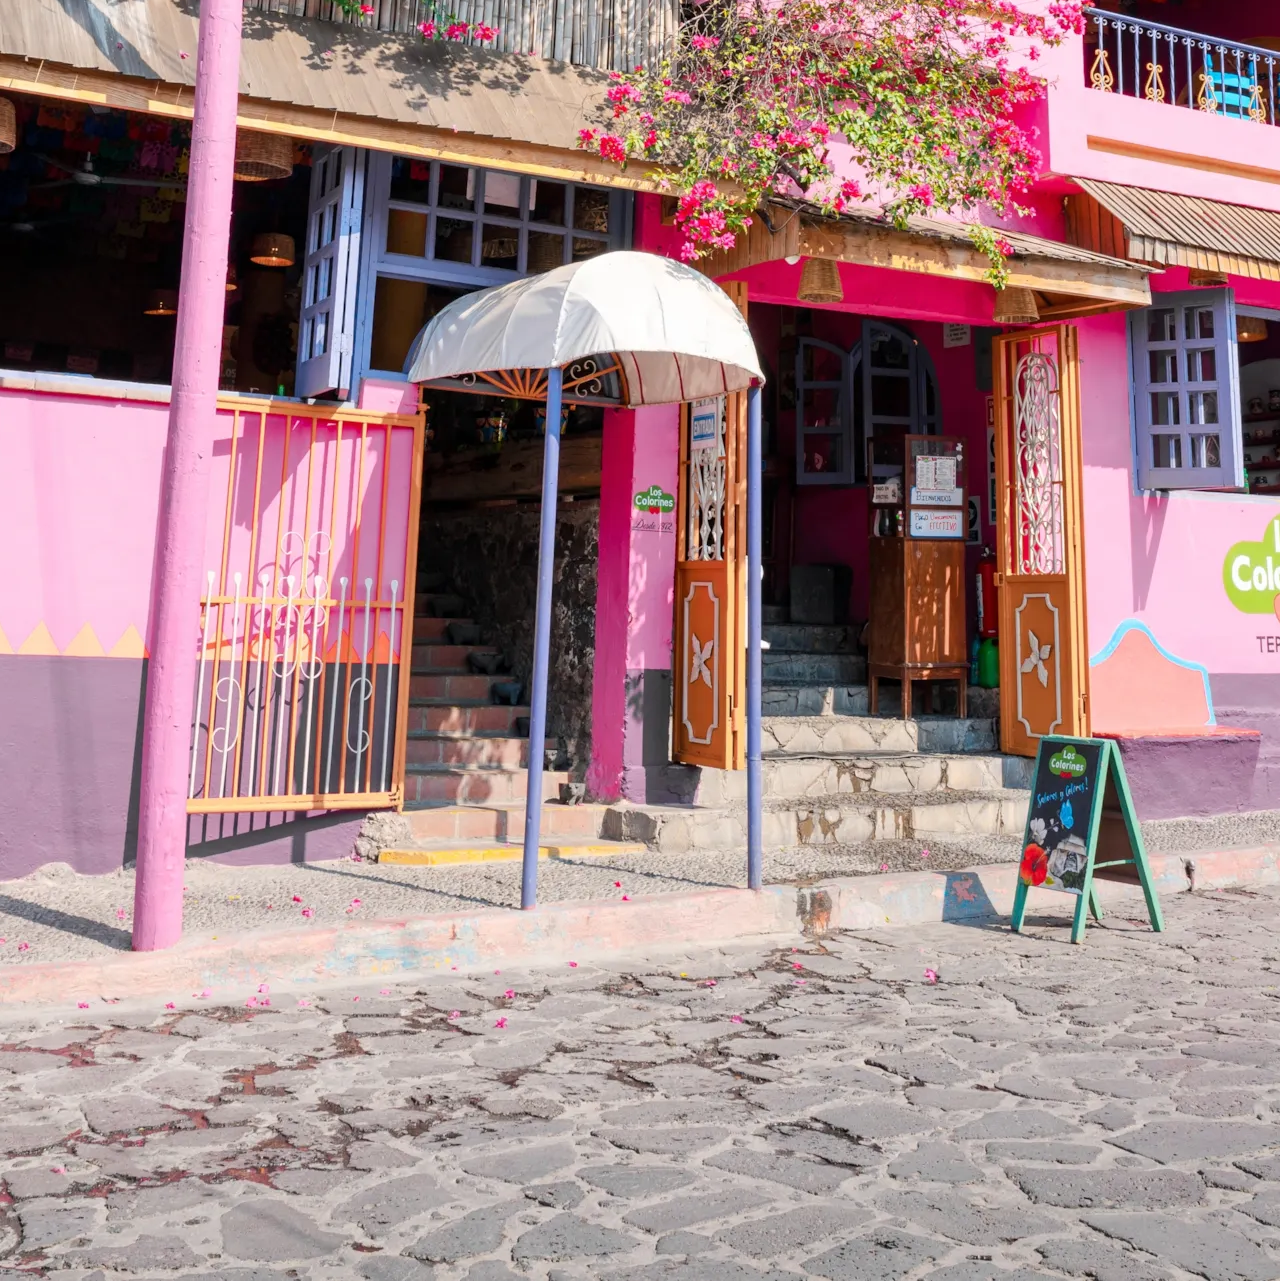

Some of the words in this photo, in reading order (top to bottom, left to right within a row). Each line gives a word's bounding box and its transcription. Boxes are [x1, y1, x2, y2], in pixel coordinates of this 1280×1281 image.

[650, 487, 662, 497] Los
[635, 496, 674, 507] Colorines
[635, 518, 655, 529] Desde
[1063, 749, 1076, 760] Los
[1051, 758, 1084, 771] Colorines
